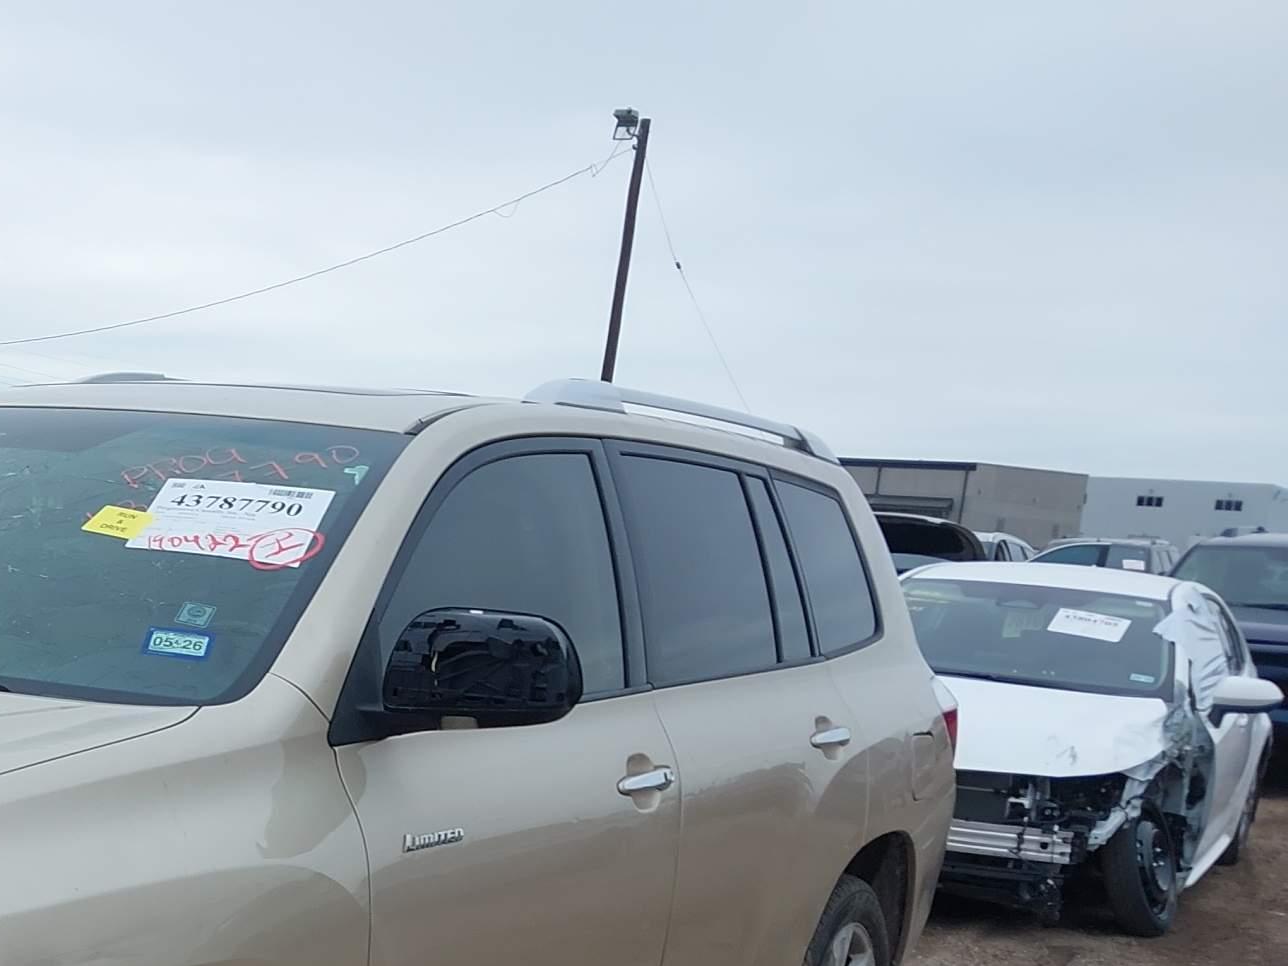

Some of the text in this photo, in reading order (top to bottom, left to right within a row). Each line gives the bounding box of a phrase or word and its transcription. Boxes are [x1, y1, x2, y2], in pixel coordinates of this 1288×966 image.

[170, 494, 304, 517] 43787790
[116, 511, 137, 520] RUN
[99, 523, 128, 533] DRIVE
[402, 827, 464, 853] LIMITED
